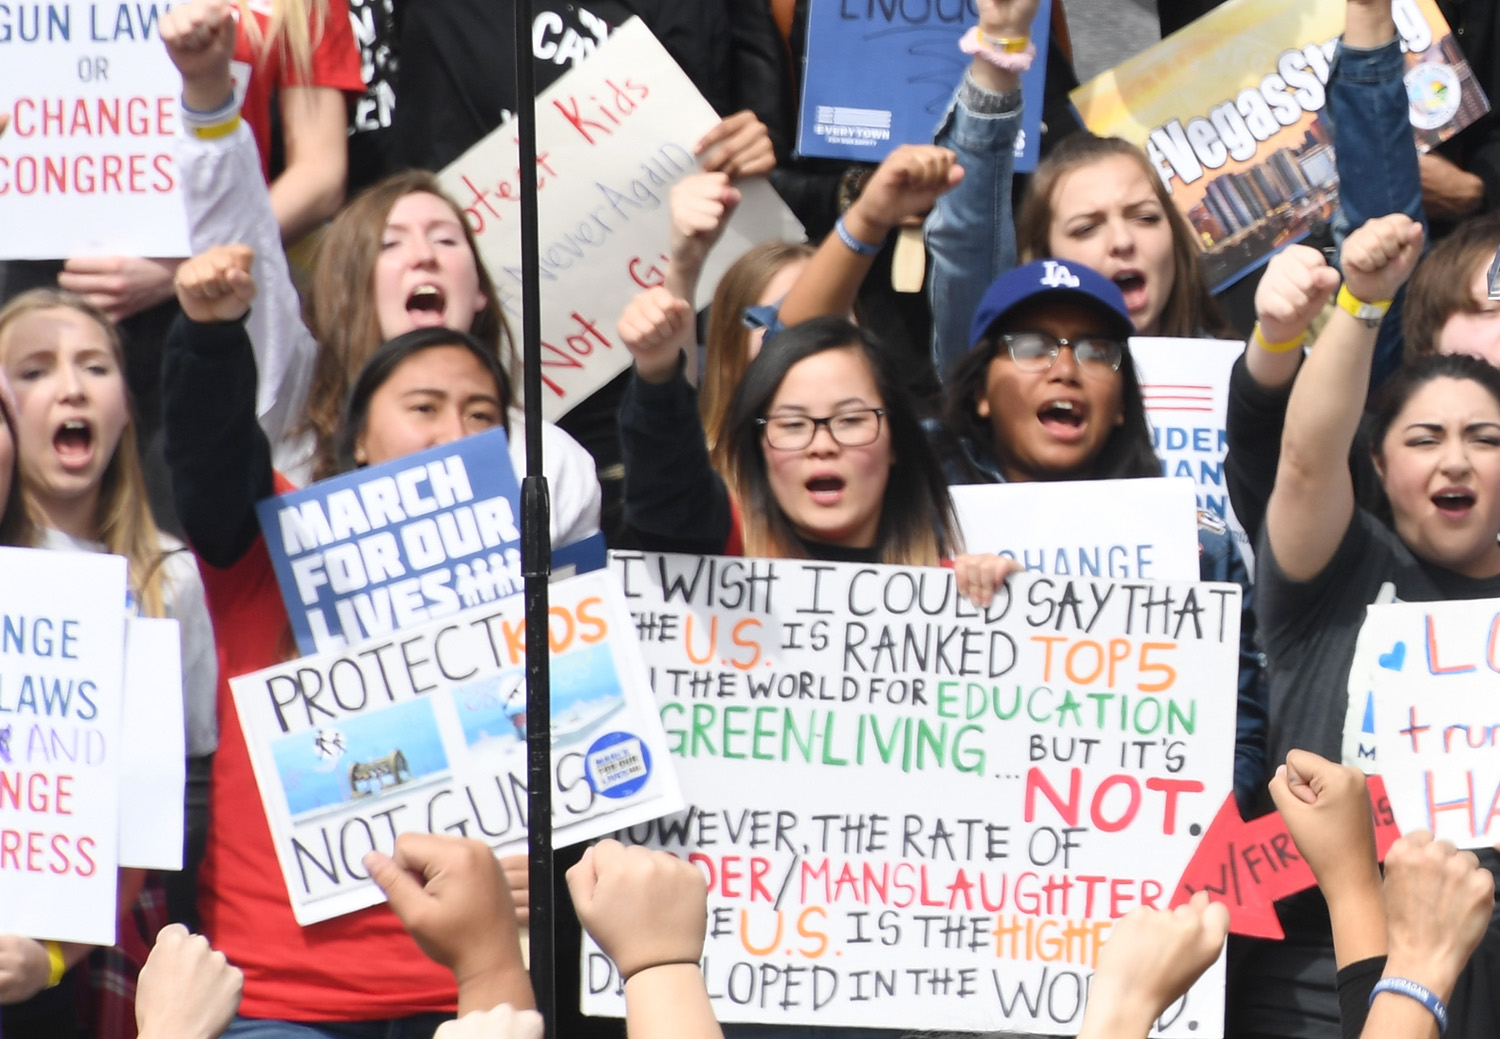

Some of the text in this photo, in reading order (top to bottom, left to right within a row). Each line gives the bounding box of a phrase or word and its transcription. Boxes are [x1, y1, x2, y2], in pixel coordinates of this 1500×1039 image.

[77, 56, 109, 82] OR
[14, 97, 175, 137] CHANGE
[552, 77, 650, 147] Kids
[1040, 261, 1080, 288] LA
[278, 454, 474, 557] MARCH
[290, 496, 521, 605] FOR OUR
[997, 544, 1154, 579] HANGE
[306, 567, 461, 655] LIVES
[612, 555, 1237, 643] I WISH I COULD SAY THAT
[266, 596, 608, 734] PROTECT KDS
[684, 613, 771, 671] U.S.
[782, 621, 831, 652] IS
[843, 621, 1018, 679] RANKED
[665, 668, 737, 698] THE
[747, 671, 860, 702] WORLD
[869, 677, 928, 707] FOR
[937, 681, 1197, 736] EDUCATION
[27, 723, 106, 765] AND
[1029, 734, 1100, 764] BUT
[1121, 737, 1186, 773] IT'S
[1, 829, 96, 878] RESS
[291, 803, 407, 894] NOT
[811, 814, 888, 854] THE
[902, 814, 1010, 861] RATE
[1028, 826, 1089, 869] OF
[668, 852, 1163, 918] DER/MANSLAUGHTER
[740, 905, 843, 959] U.S.
[847, 910, 902, 945] IS
[912, 915, 992, 952] THE
[588, 953, 839, 1012] DLOPED
[849, 968, 897, 1002] IN
[906, 967, 978, 998] THE
